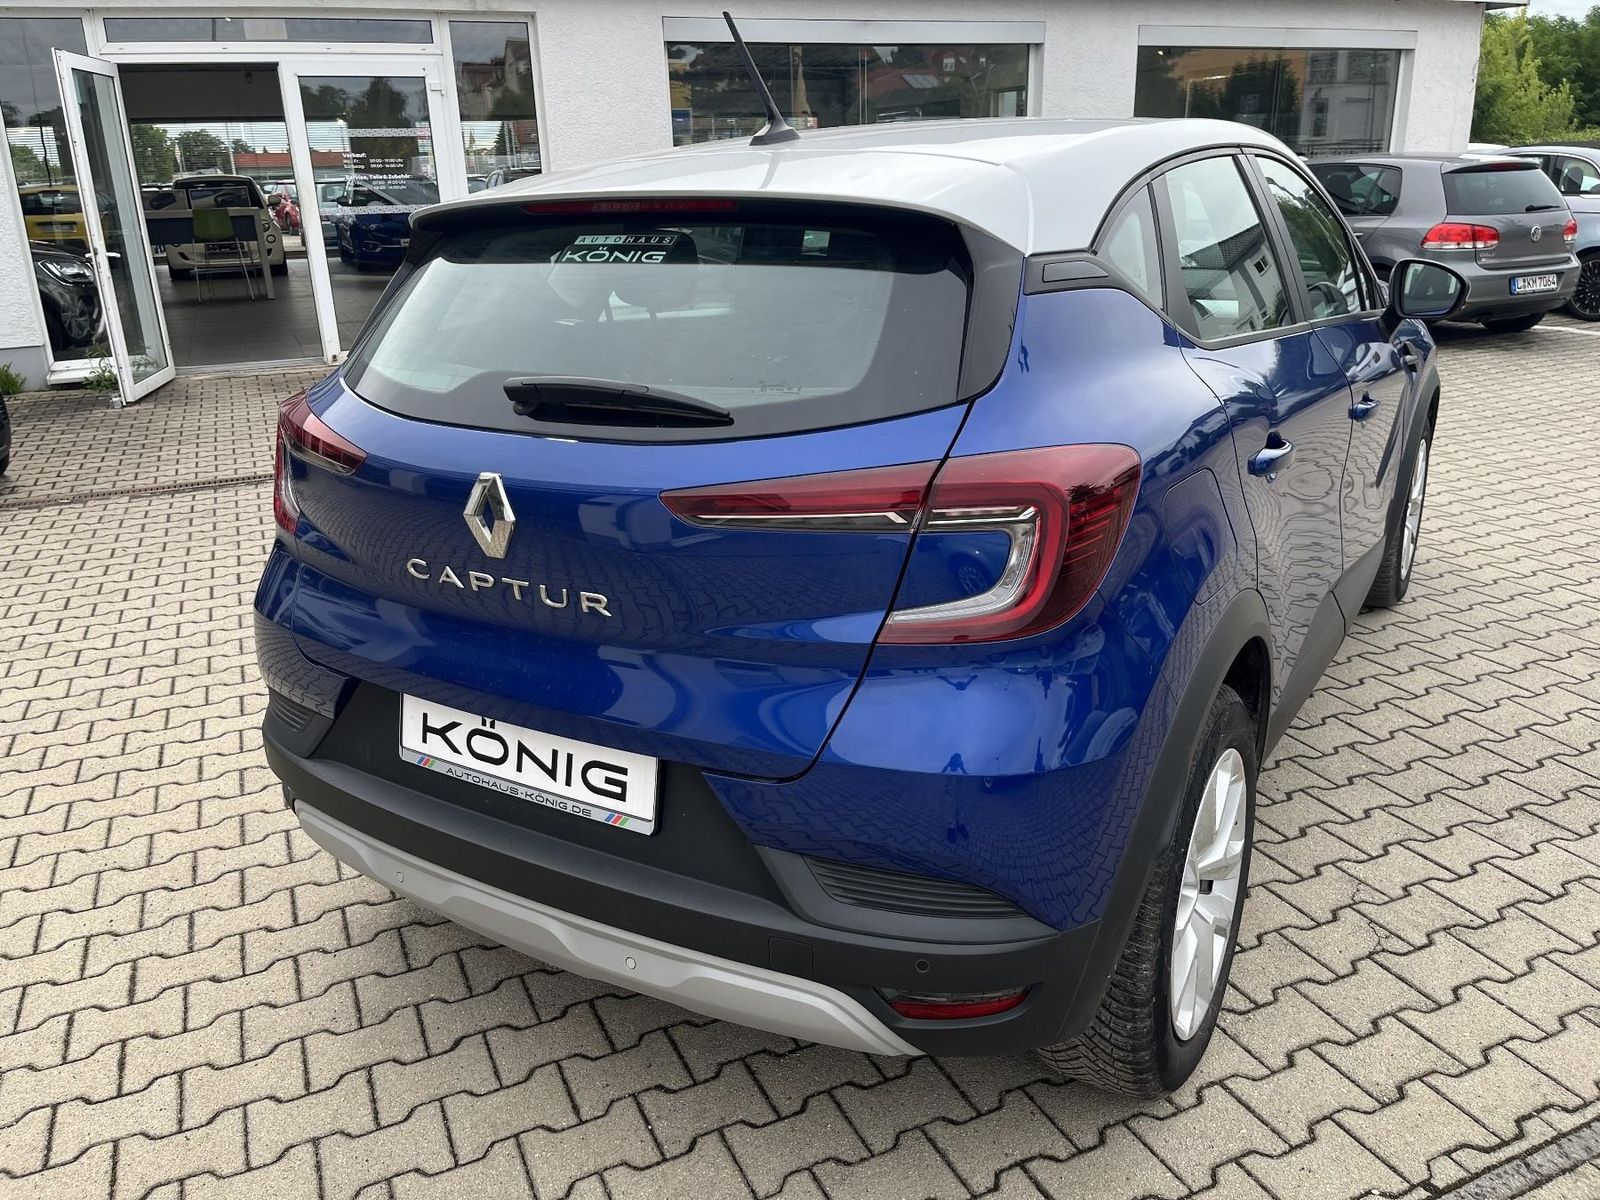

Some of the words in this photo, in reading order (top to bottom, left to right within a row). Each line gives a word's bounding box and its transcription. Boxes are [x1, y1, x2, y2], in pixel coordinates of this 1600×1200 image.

[562, 246, 667, 263] KÖNIG
[579, 236, 672, 244] AUTOHAUS
[406, 558, 612, 617] CAPTUR
[421, 712, 629, 802] KÖNIG
[445, 767, 592, 818] AUTOHAUS-KÖNIG.DE
